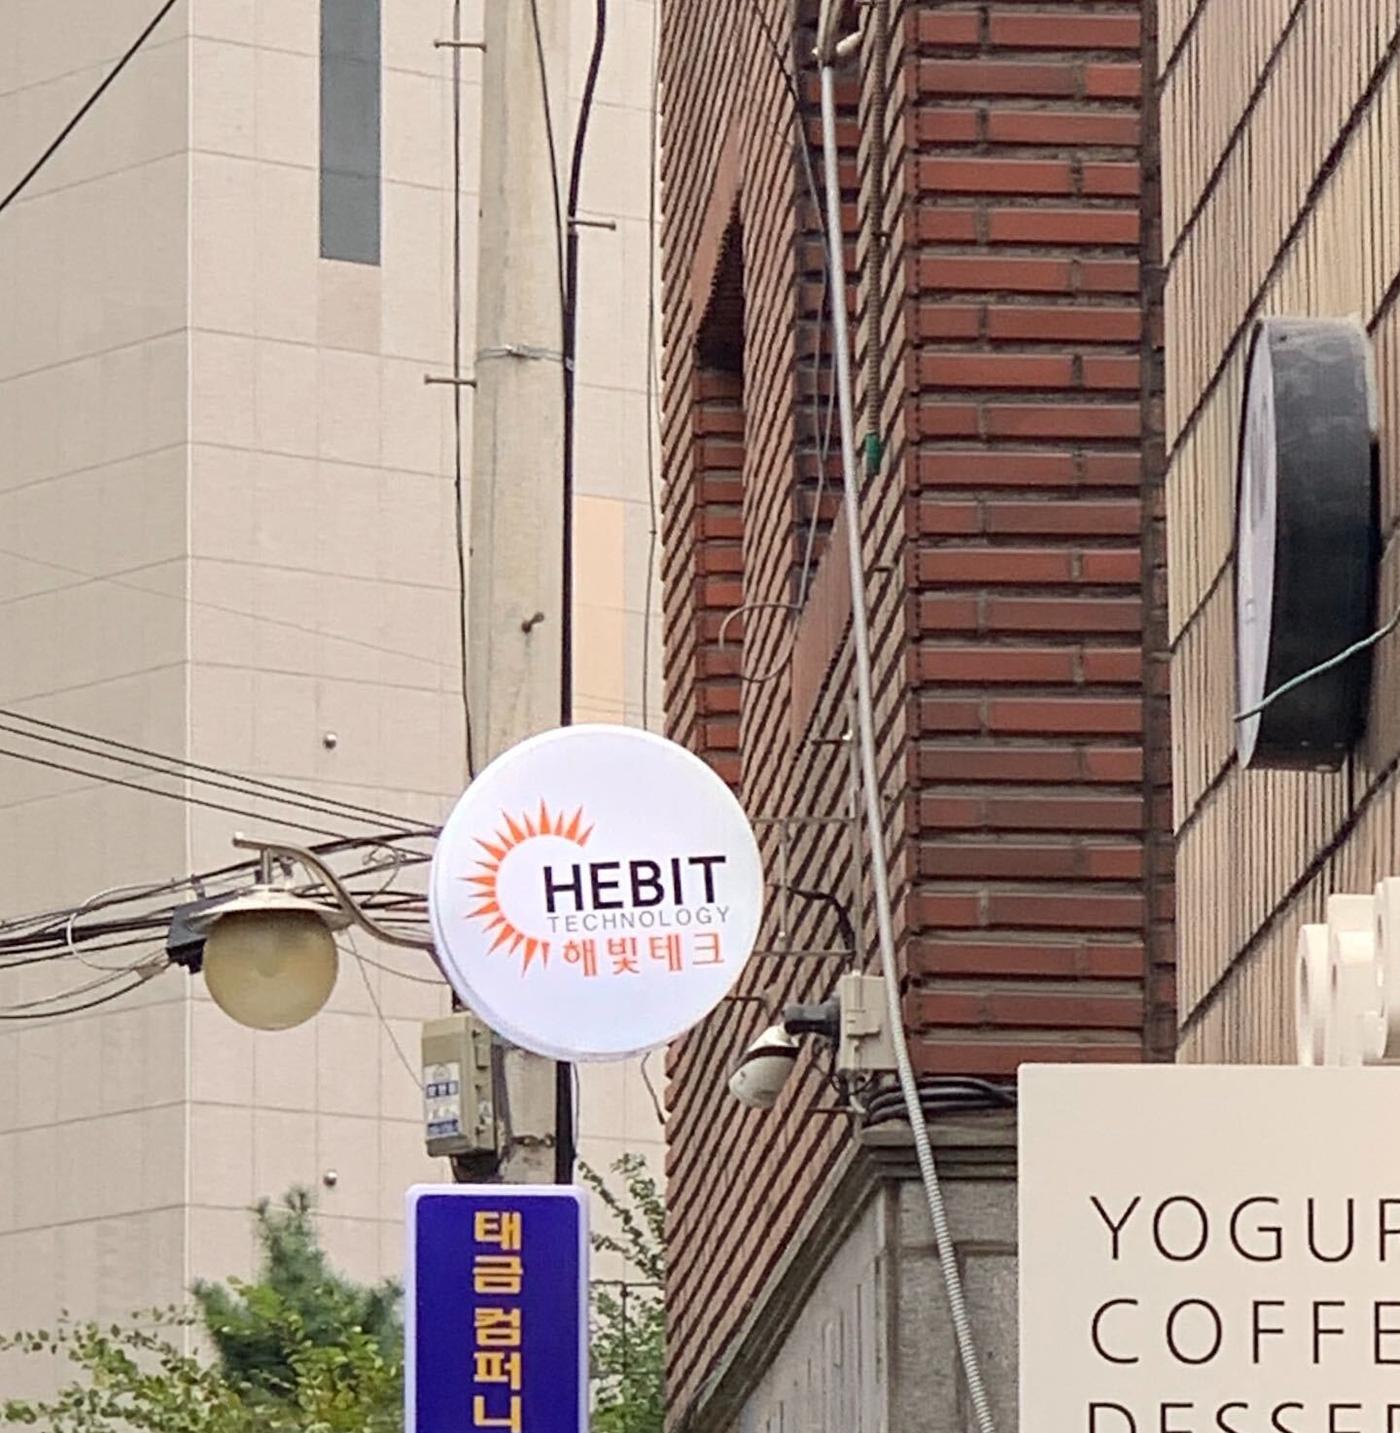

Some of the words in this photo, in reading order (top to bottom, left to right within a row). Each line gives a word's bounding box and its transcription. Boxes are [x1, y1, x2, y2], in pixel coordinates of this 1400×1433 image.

[543, 855, 727, 913] HEBIT
[546, 906, 731, 934] TECHNOLOGY
[562, 931, 726, 978] 해빛테크
